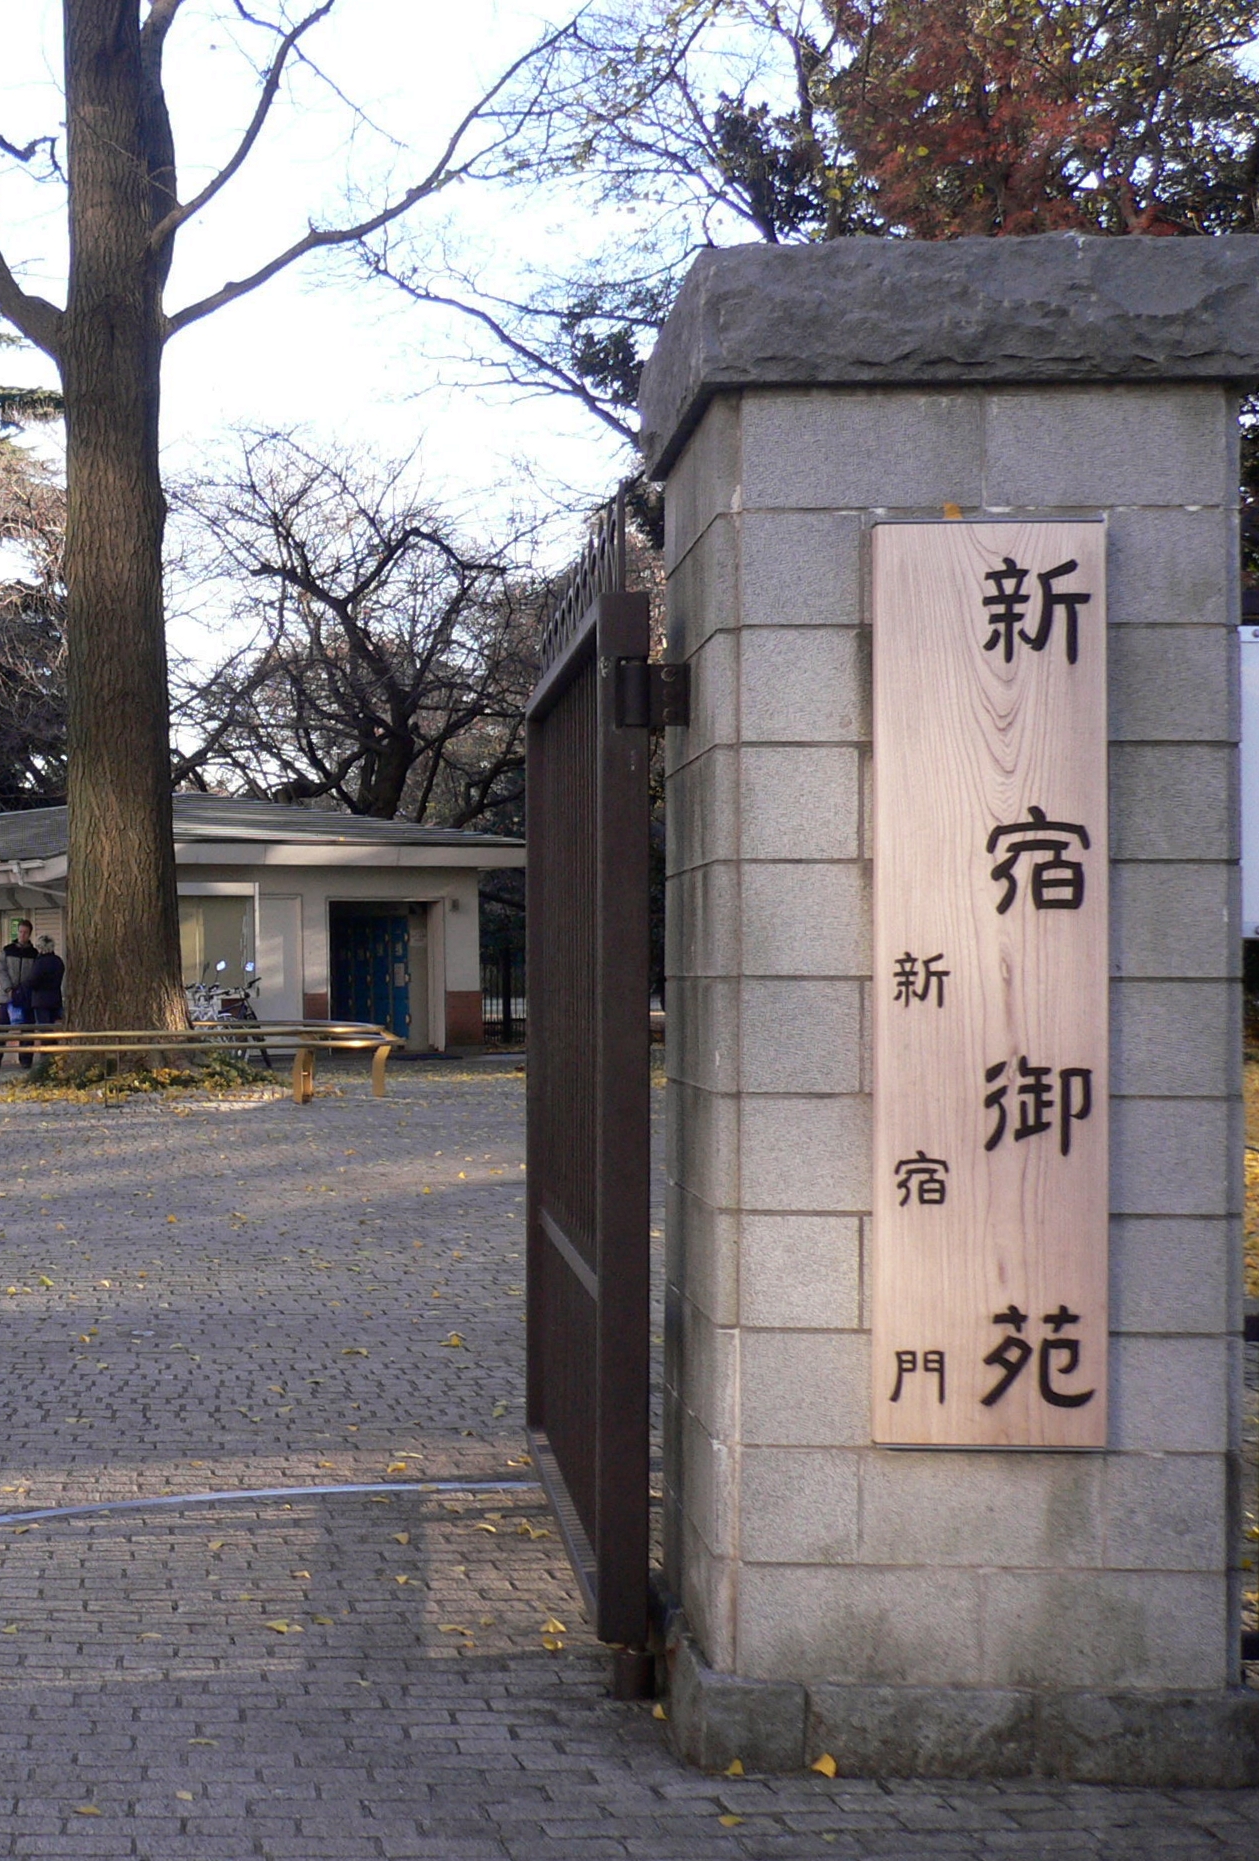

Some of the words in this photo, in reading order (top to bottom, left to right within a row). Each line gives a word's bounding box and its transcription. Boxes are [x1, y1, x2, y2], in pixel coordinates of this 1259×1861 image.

[890, 951, 950, 1405] 新宿門
[981, 556, 1096, 1410] 新宿御苑
